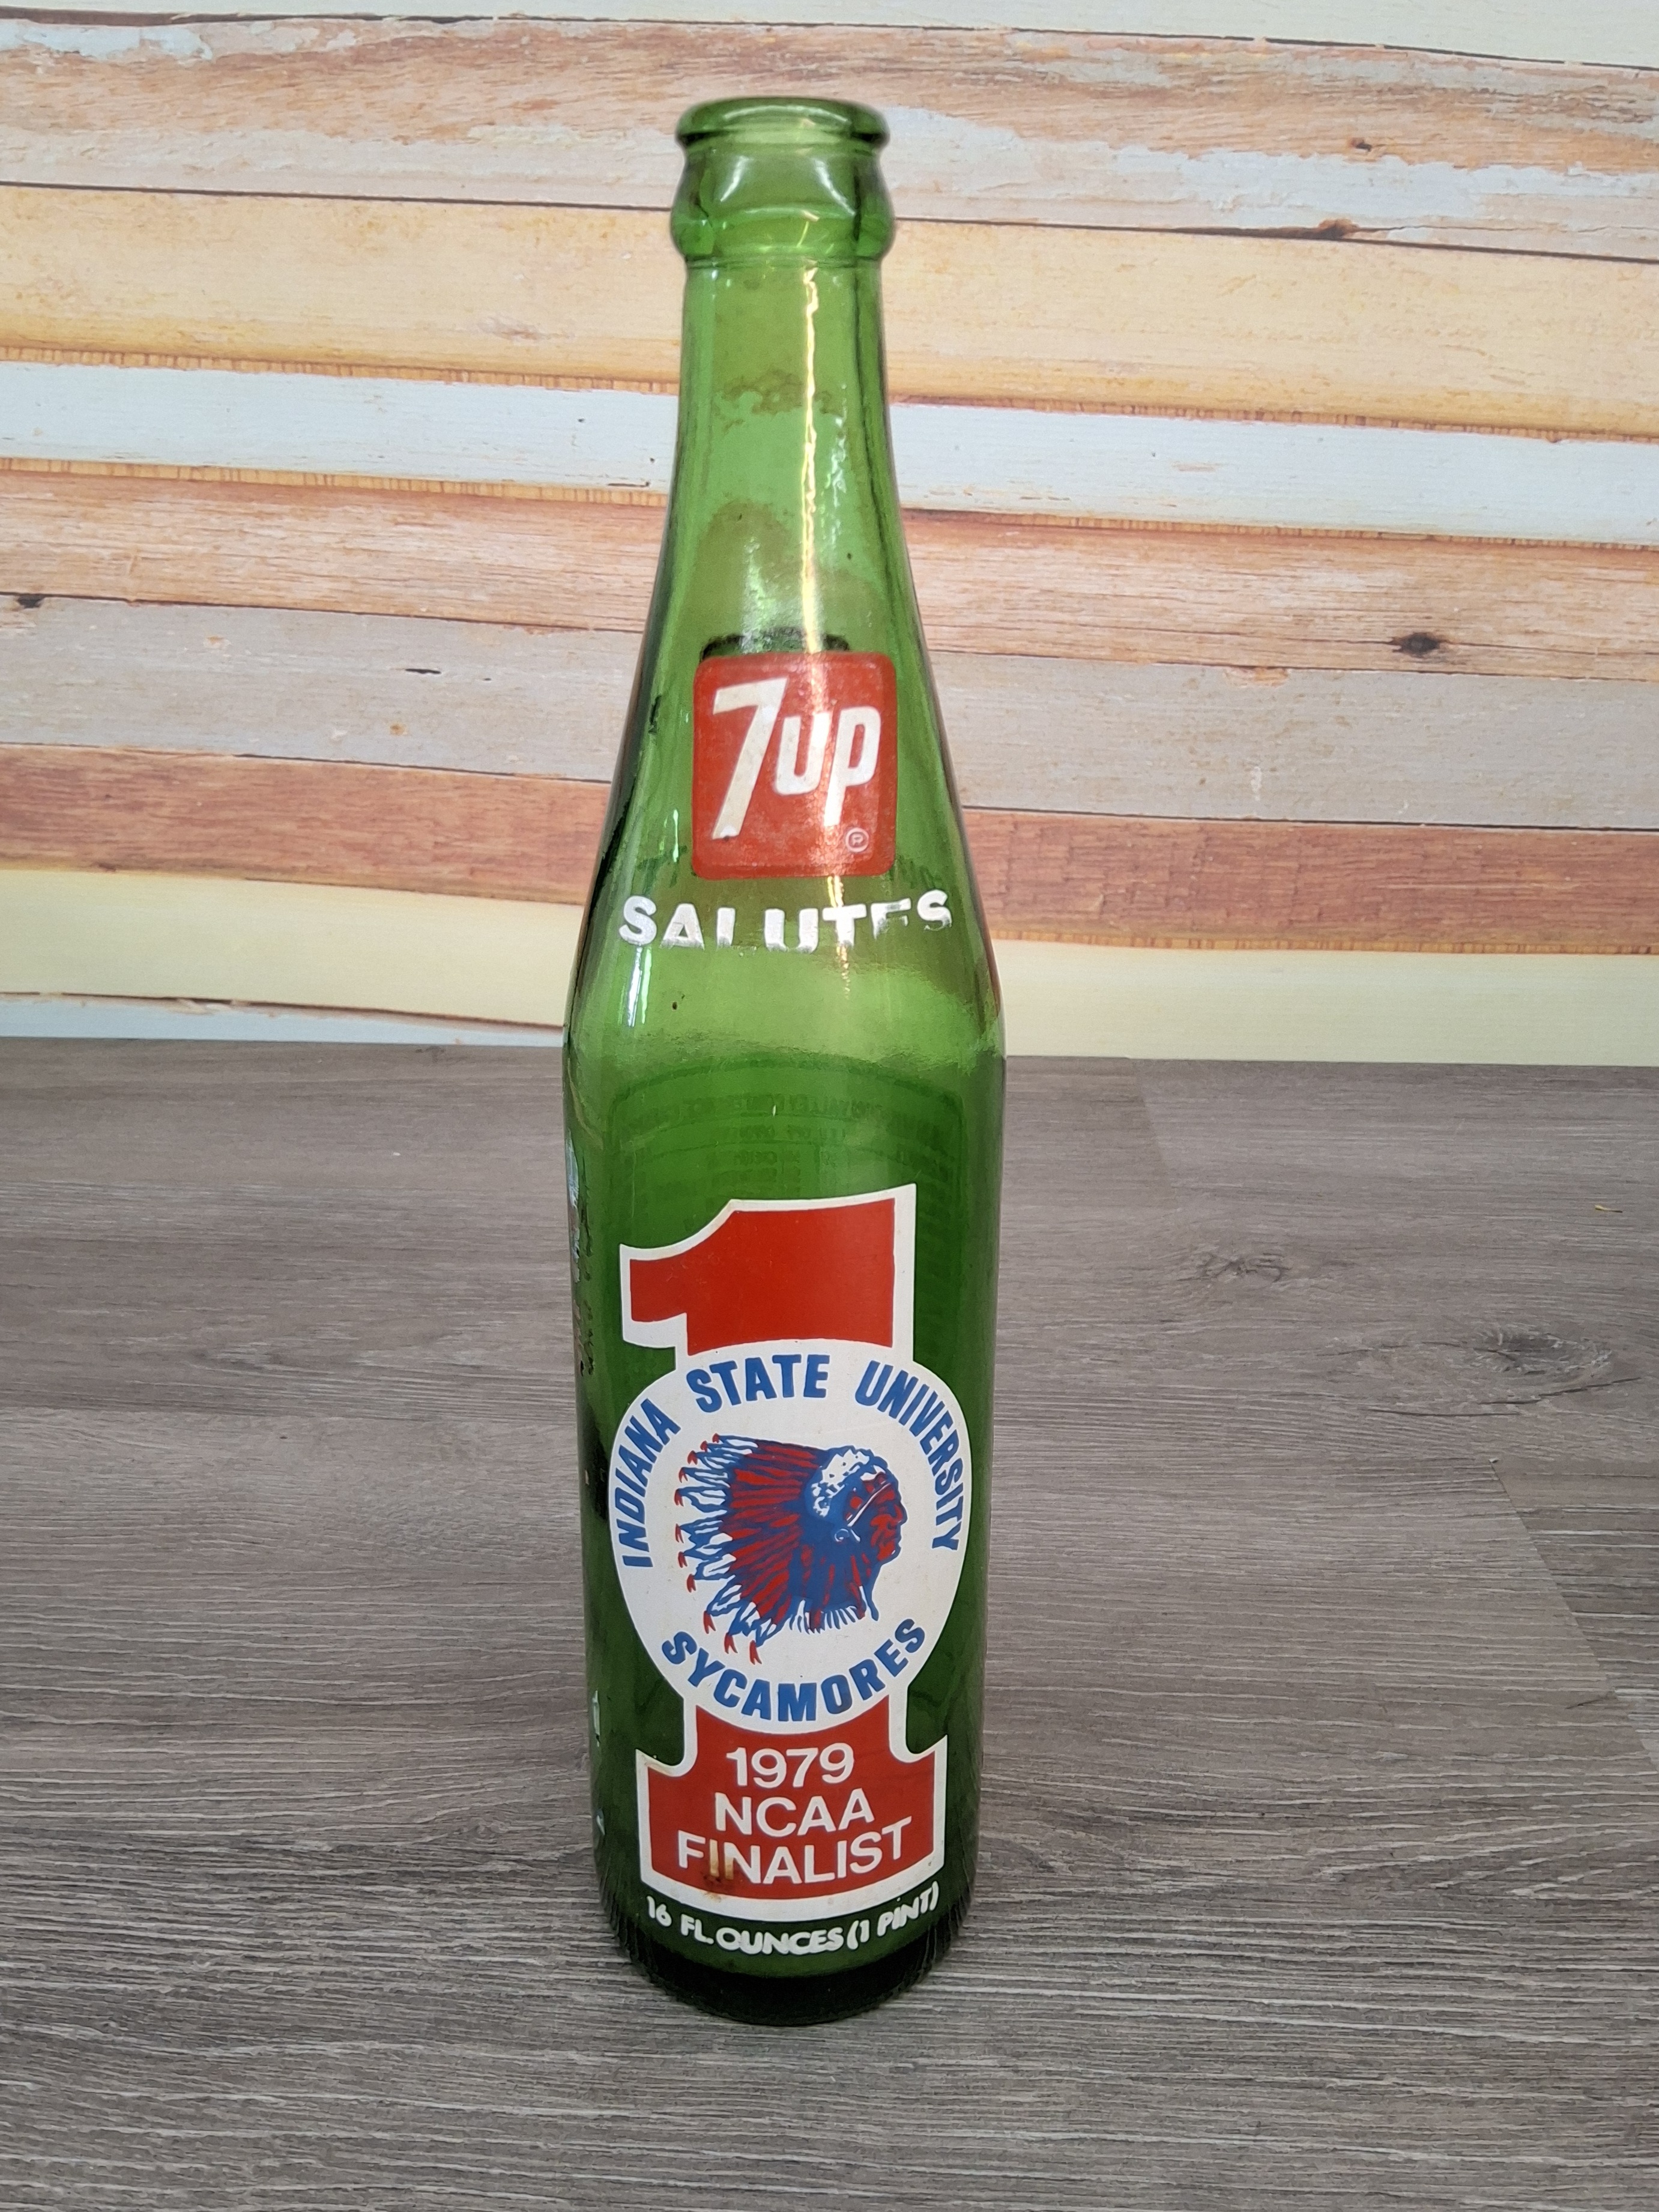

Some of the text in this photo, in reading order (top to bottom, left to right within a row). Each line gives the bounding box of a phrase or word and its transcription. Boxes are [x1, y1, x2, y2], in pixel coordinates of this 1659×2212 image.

[614, 1354, 963, 1568] INDIANA STATE UNIVERSITY
[661, 1618, 925, 1722] SYCAMORES
[726, 1742, 855, 1789] 1979
[714, 1787, 875, 1837] NCAA
[677, 1816, 913, 1885] FINALIST
[646, 1896, 672, 1927] 16
[716, 1927, 844, 1955] OUNCES
